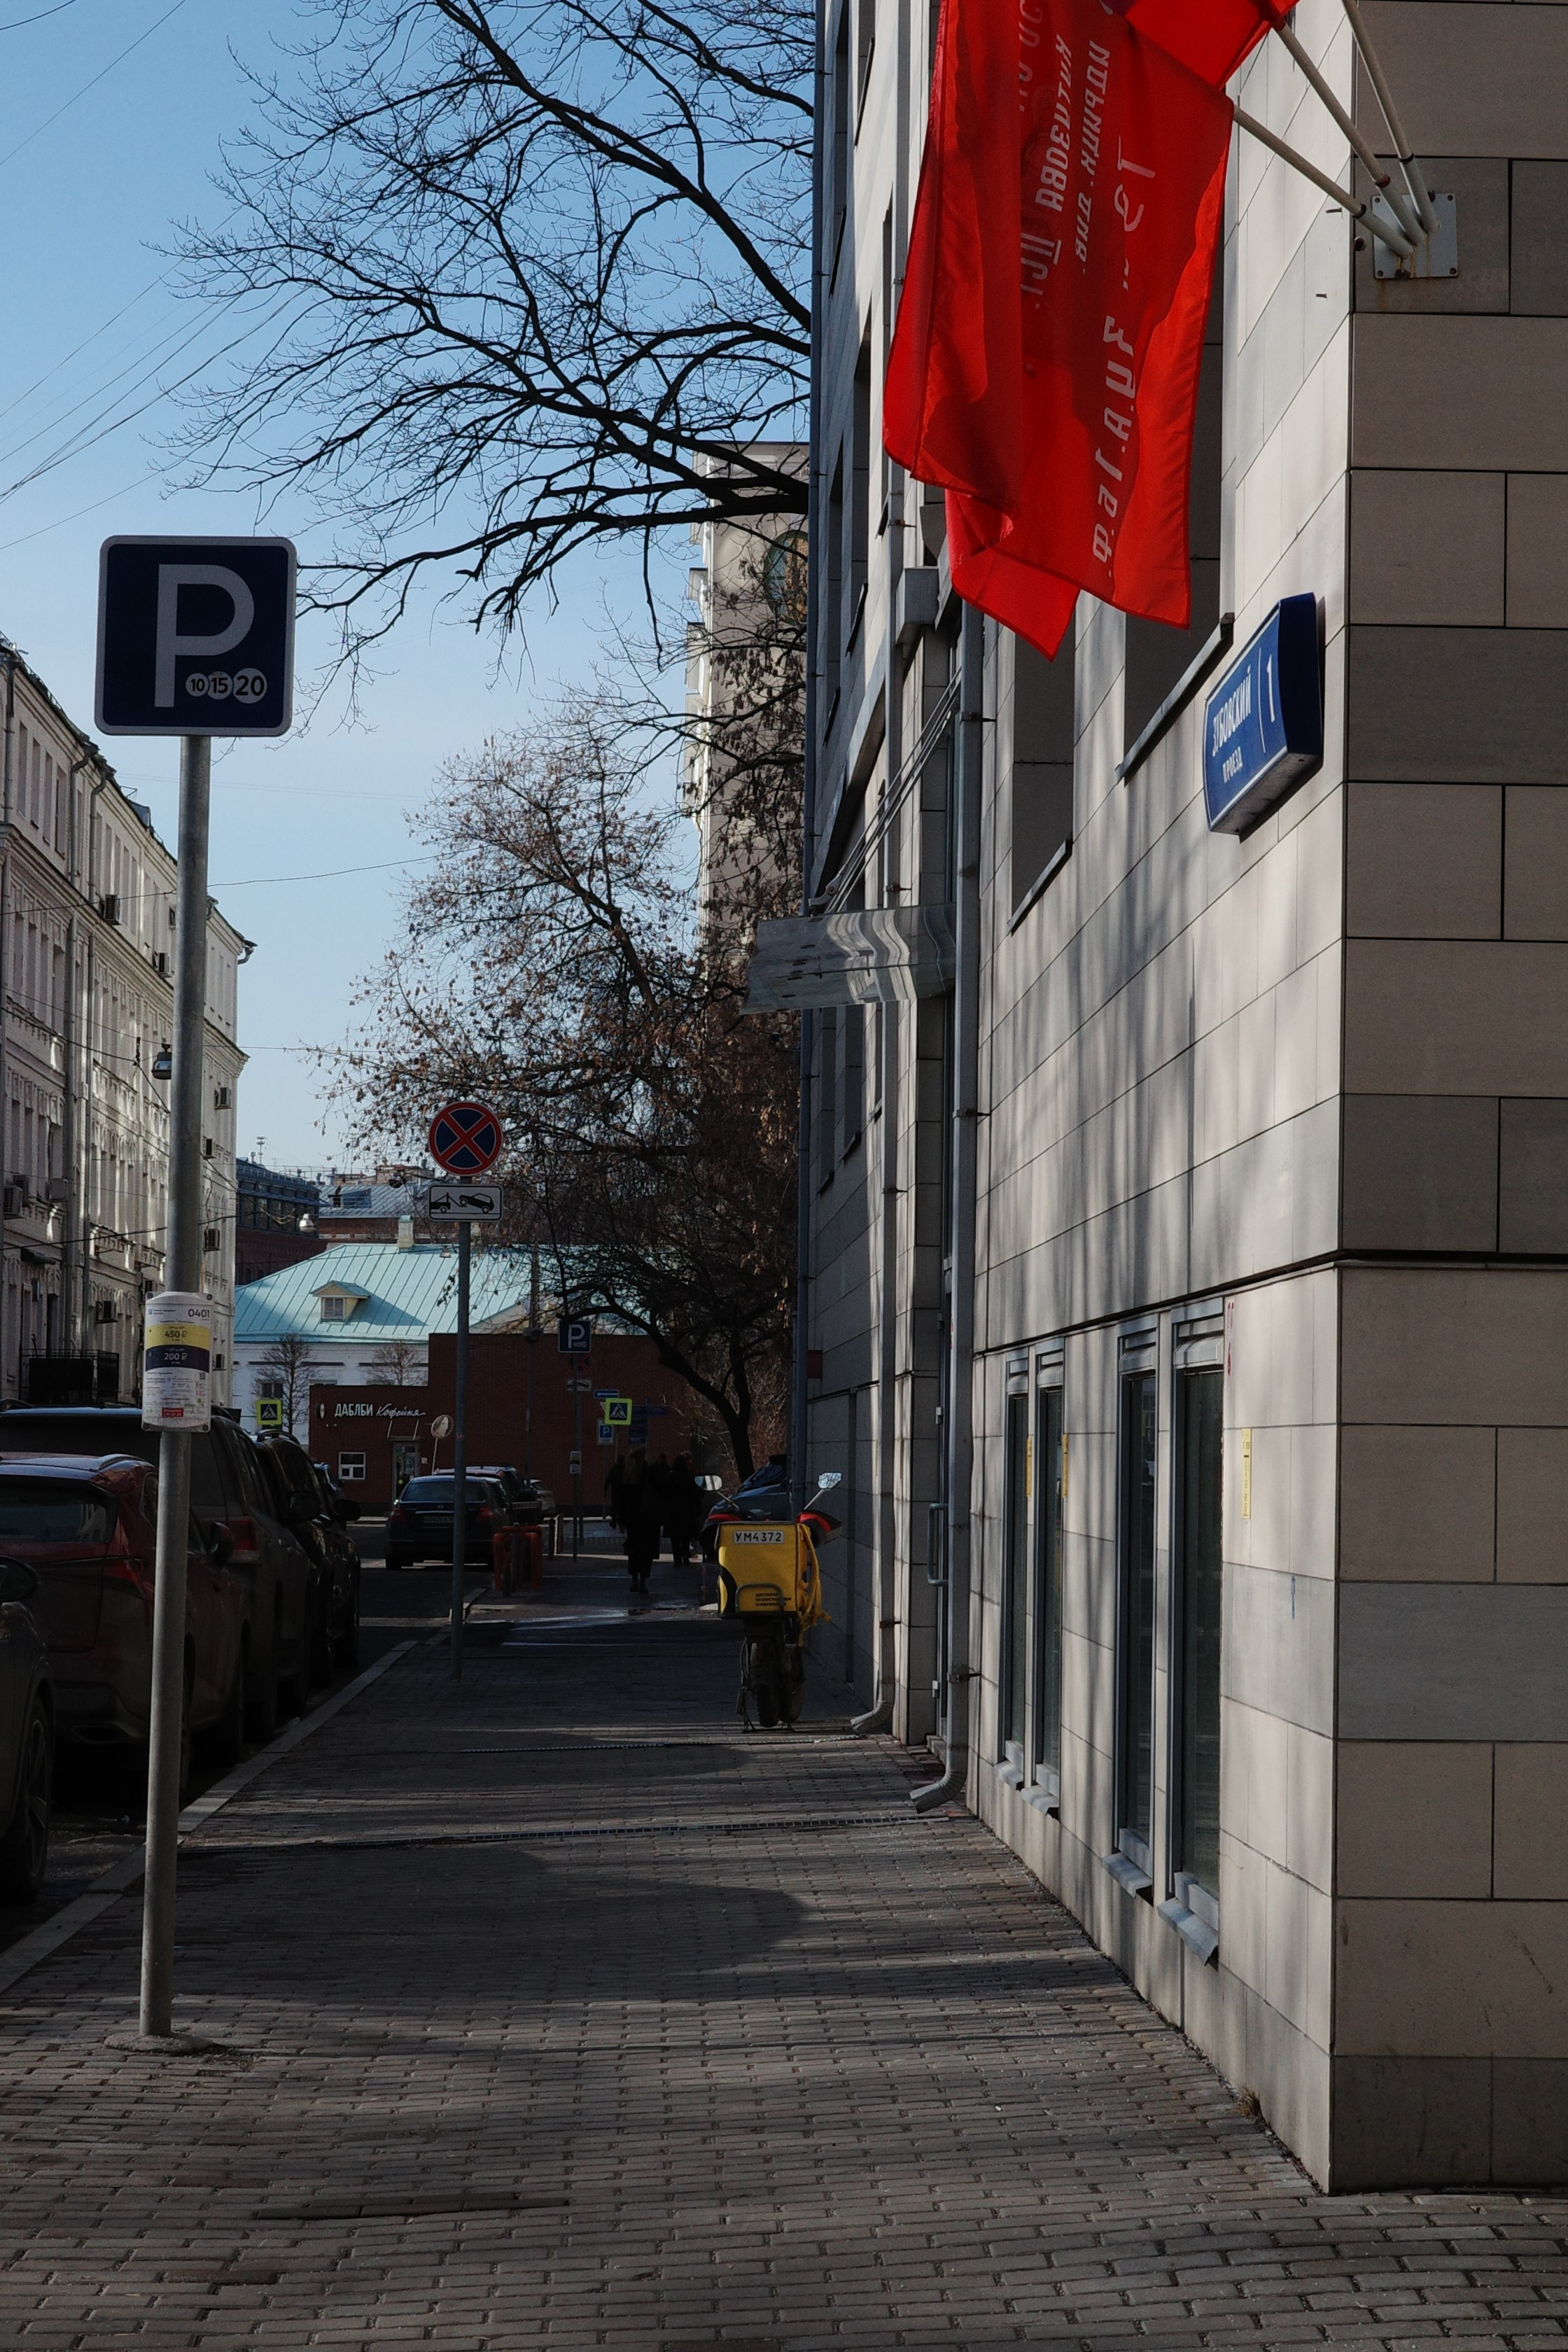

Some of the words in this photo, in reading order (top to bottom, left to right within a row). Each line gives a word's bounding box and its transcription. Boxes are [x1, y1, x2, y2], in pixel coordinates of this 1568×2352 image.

[155, 564, 255, 708] P
[190, 678, 206, 692] 10
[210, 677, 228, 694] 15
[235, 676, 265, 696] 20
[1266, 654, 1275, 723] 1
[1212, 664, 1252, 757] ЗУБОВСКИЙ
[1222, 746, 1243, 784] ПРОЕЗД
[188, 1308, 210, 1318] 0401
[568, 1324, 585, 1349] P
[164, 1352, 180, 1361] 200
[334, 1403, 373, 1418] ДАБЛБИ
[376, 1403, 426, 1420] Кофейня
[603, 1426, 610, 1436] P
